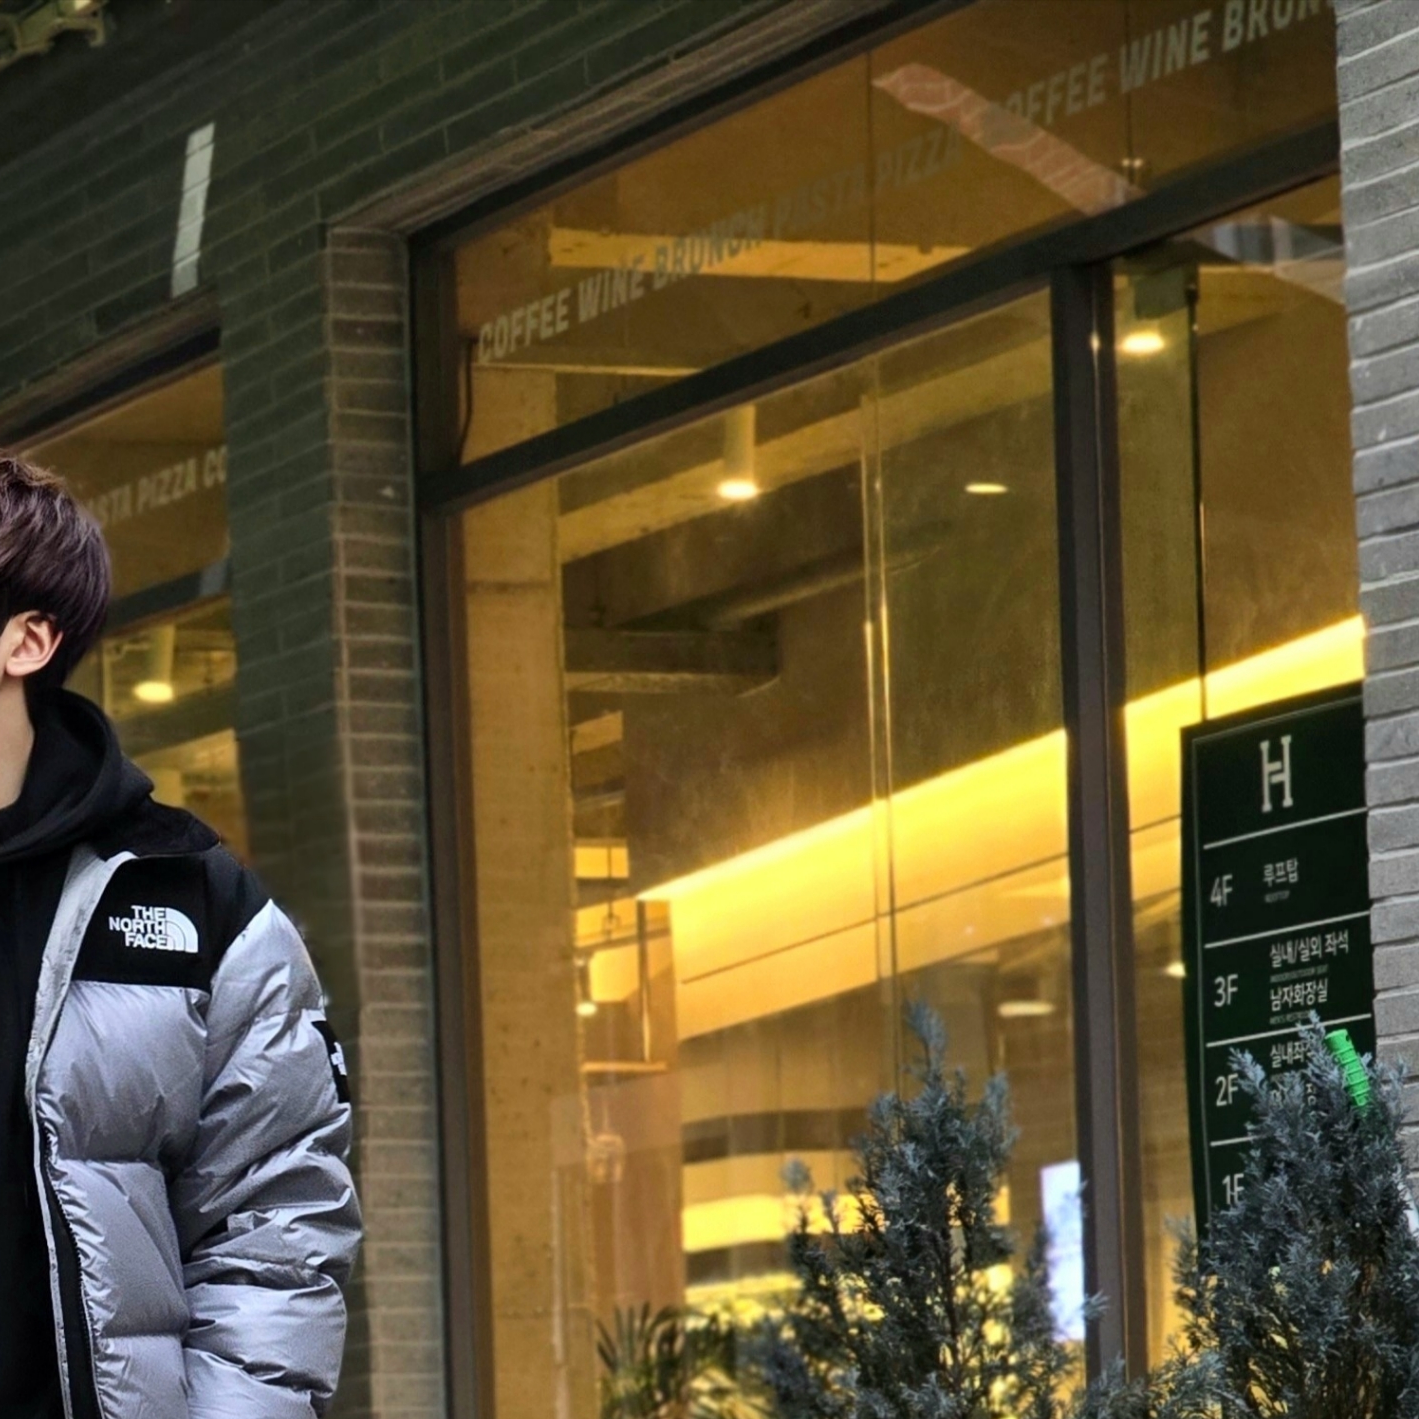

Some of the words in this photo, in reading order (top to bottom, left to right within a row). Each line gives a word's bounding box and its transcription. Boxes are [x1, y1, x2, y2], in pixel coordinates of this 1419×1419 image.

[478, 287, 572, 364] COFFEE
[578, 255, 645, 324] WINE
[651, 204, 766, 291] BRUNCH
[1118, 9, 1213, 95] WINE
[137, 457, 198, 514] PIZZA
[1259, 734, 1294, 814] H
[1263, 857, 1299, 888] 루프탑
[1210, 874, 1233, 908] 4F
[108, 916, 167, 935] NORTH
[130, 904, 167, 921] THE
[124, 931, 168, 951] FACE
[1269, 934, 1323, 969] 실내/실외
[1324, 929, 1349, 957] 좌석
[1213, 974, 1238, 1008] 3F
[1269, 977, 1329, 1012] 남자화장실
[1215, 1073, 1239, 1107] 2F
[1222, 1173, 1245, 1206] 1F
